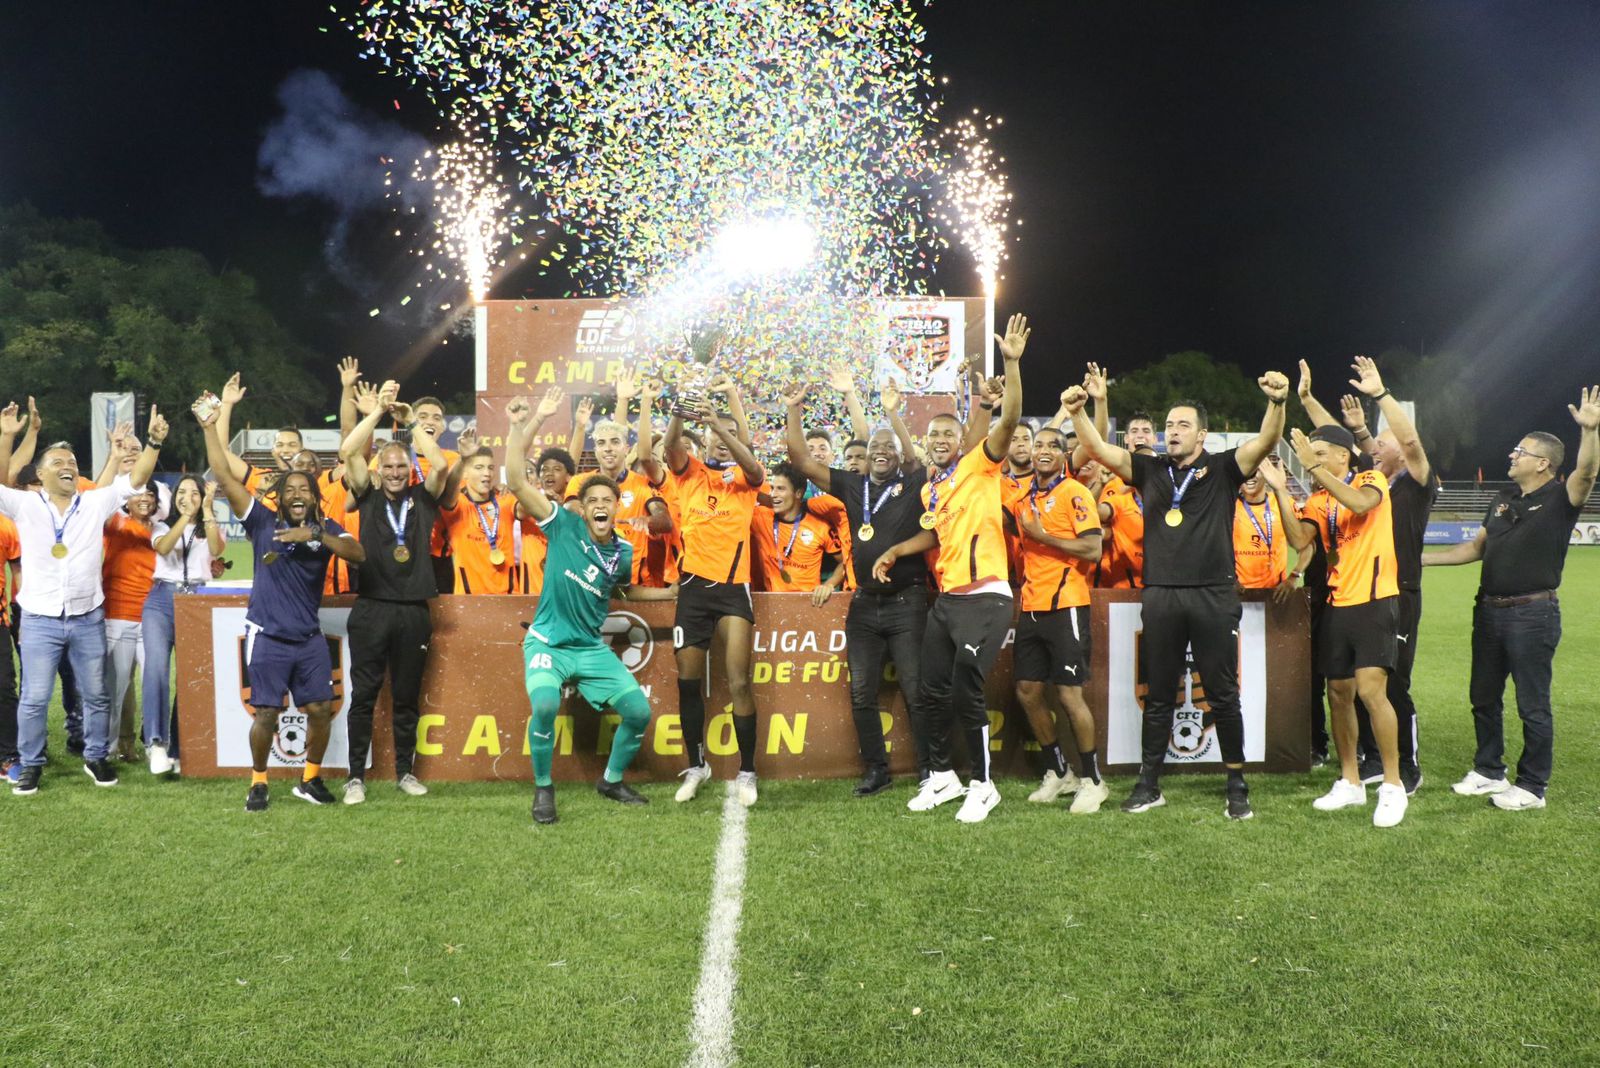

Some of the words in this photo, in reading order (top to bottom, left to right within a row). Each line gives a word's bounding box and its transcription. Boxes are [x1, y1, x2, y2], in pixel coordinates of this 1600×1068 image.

[576, 329, 613, 345] LDF
[753, 630, 818, 652] LIGA
[753, 661, 792, 684] DE
[281, 716, 305, 724] CFC
[1176, 711, 1200, 720] CFC
